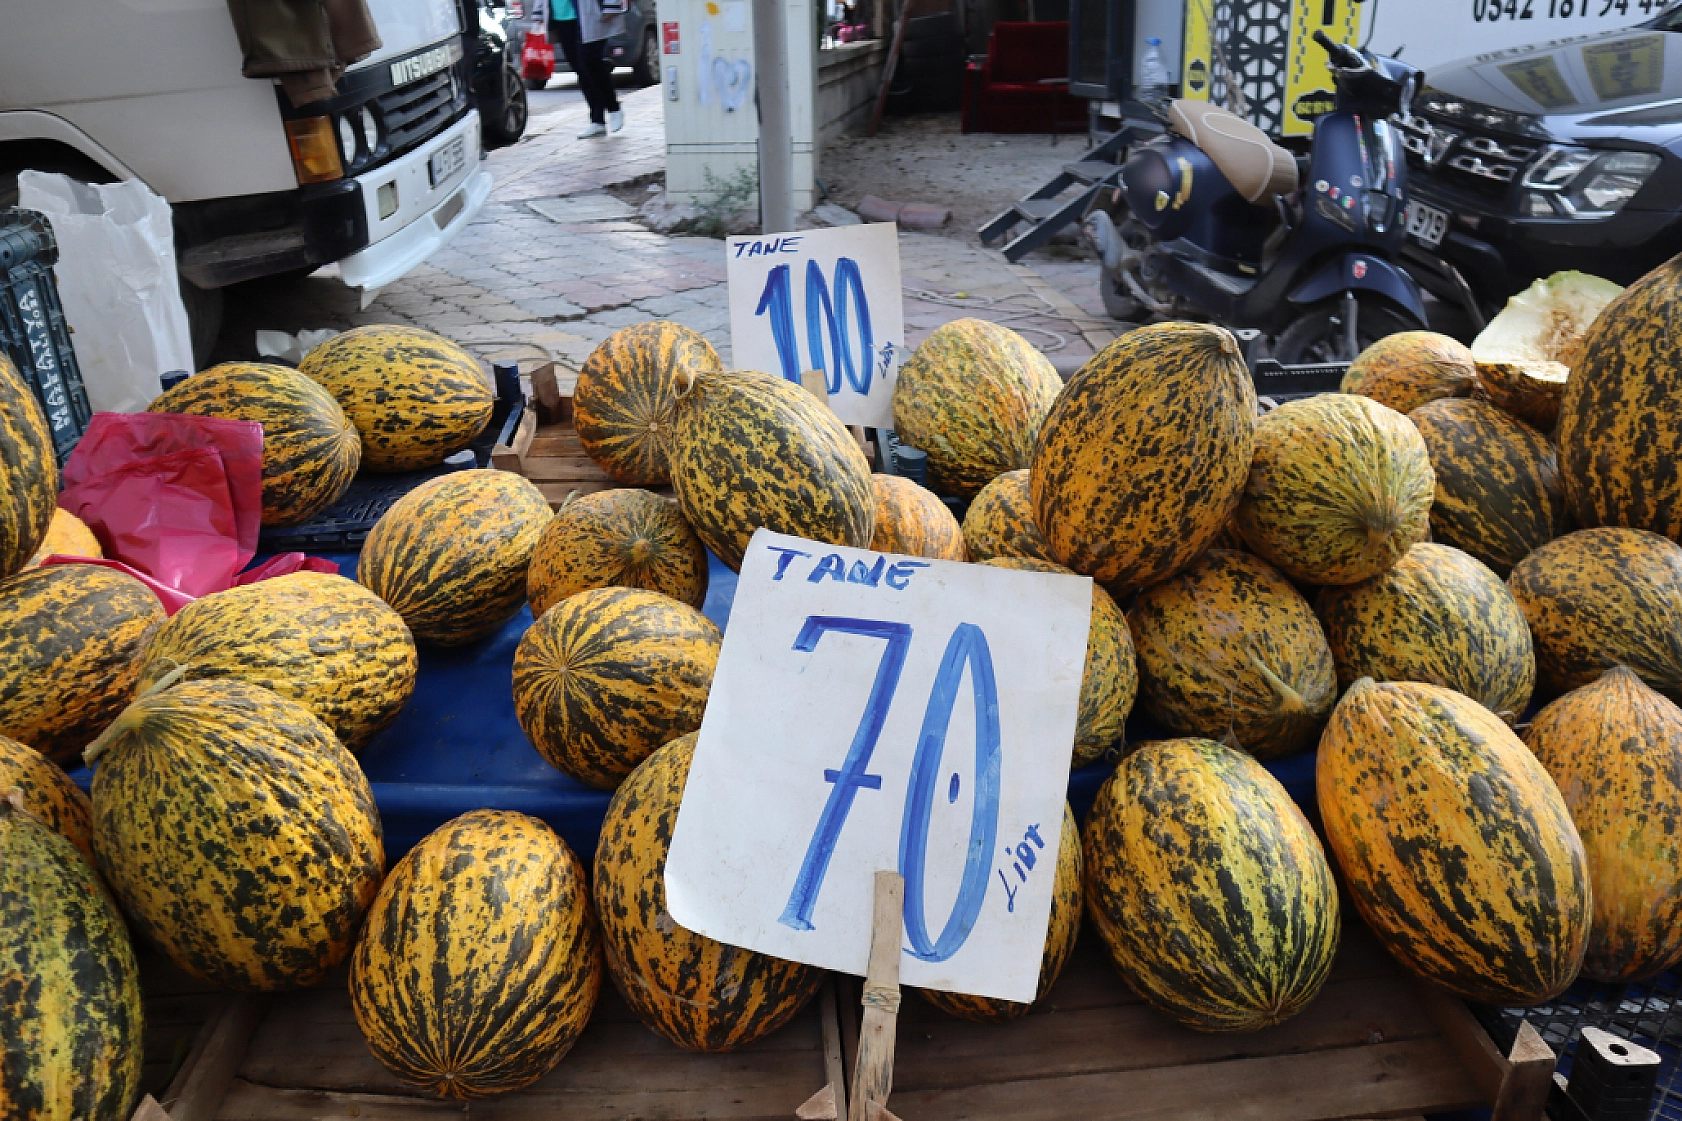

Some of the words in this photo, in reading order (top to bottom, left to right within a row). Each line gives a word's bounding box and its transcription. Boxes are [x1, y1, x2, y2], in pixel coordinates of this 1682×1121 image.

[1474, 0, 1533, 22] 0542
[733, 235, 804, 258] TANE
[19, 288, 69, 432] MALATYA
[755, 257, 875, 397] 100
[767, 545, 931, 591] TANE
[777, 615, 1003, 964] 70
